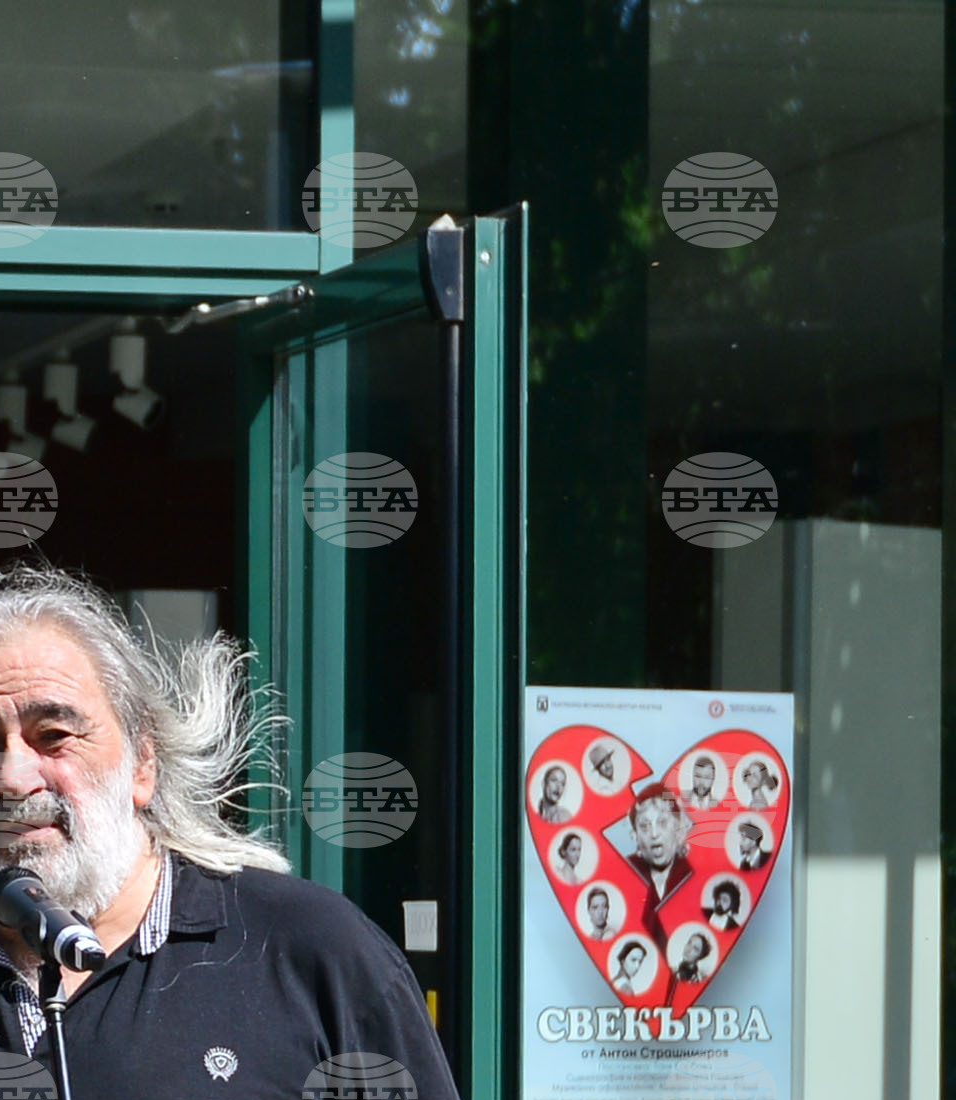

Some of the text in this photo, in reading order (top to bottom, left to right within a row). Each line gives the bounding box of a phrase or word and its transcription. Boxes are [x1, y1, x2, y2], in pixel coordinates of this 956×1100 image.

[537, 1006, 773, 1043] СВЕКЪРВА
[581, 1047, 729, 1061] от Антон Страшимиров
